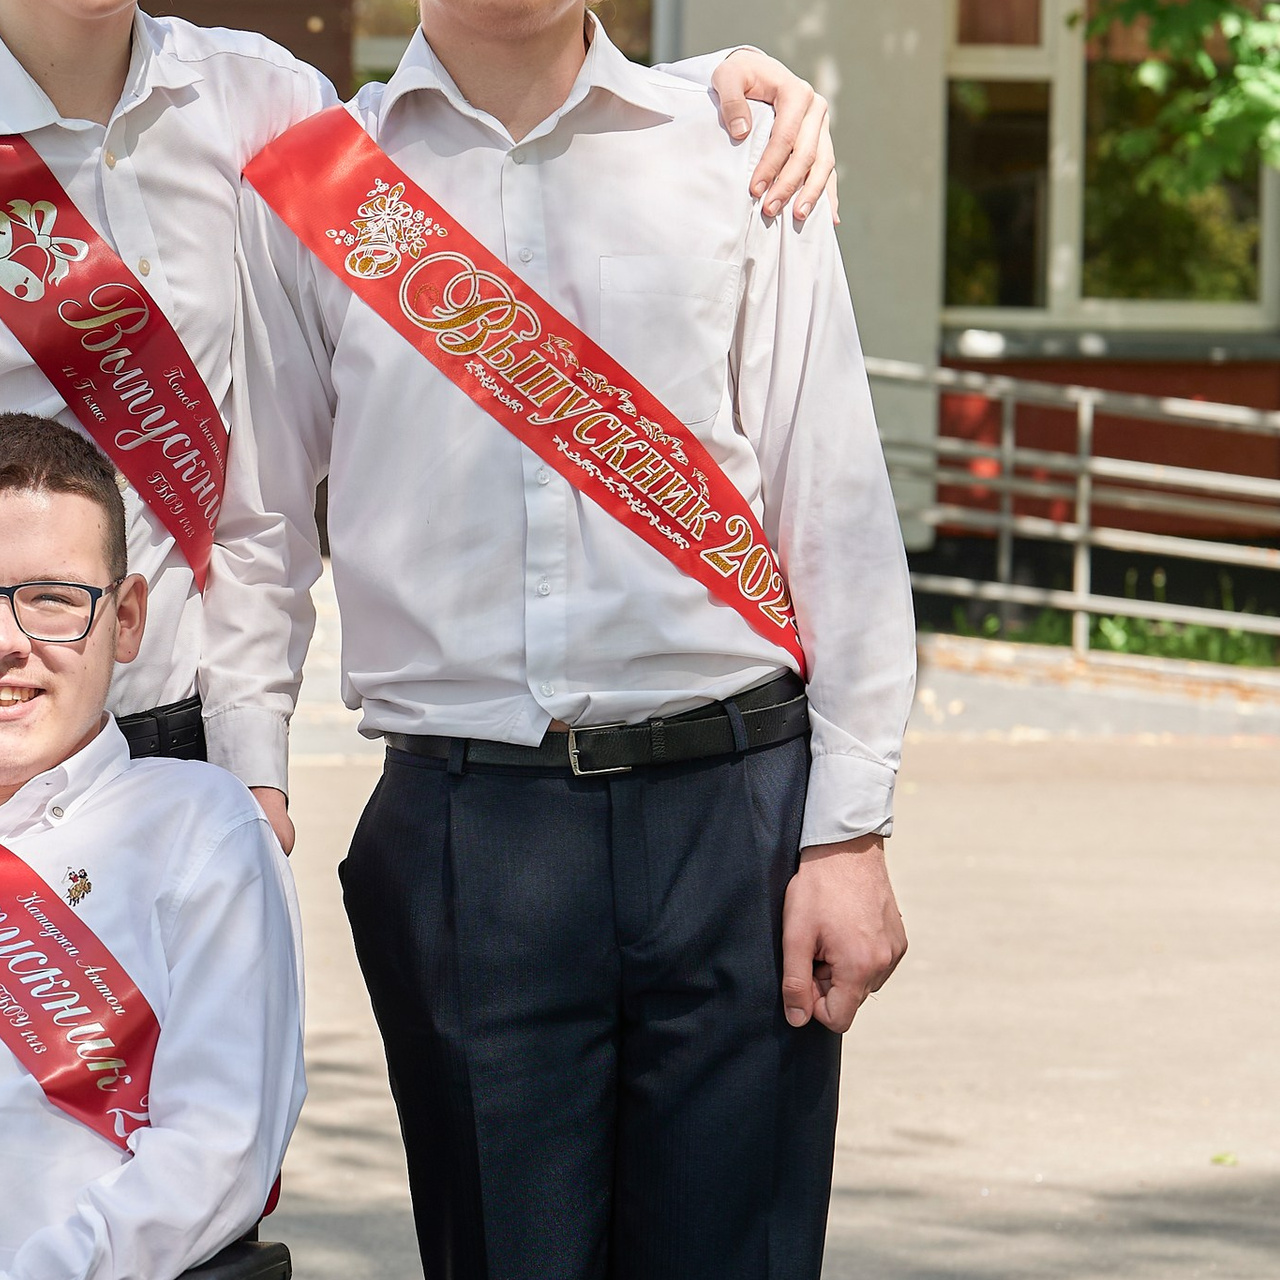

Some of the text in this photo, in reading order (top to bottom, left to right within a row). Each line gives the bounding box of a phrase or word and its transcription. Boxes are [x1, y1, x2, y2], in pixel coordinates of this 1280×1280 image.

[56, 282, 220, 537] Выпускни
[61, 365, 107, 423] 11 Г класс
[163, 365, 200, 411] Попов
[146, 471, 195, 538] ГБОУ 1413
[16, 891, 126, 1016] Катаджи Антон
[20, 1029, 47, 1054] 1413
